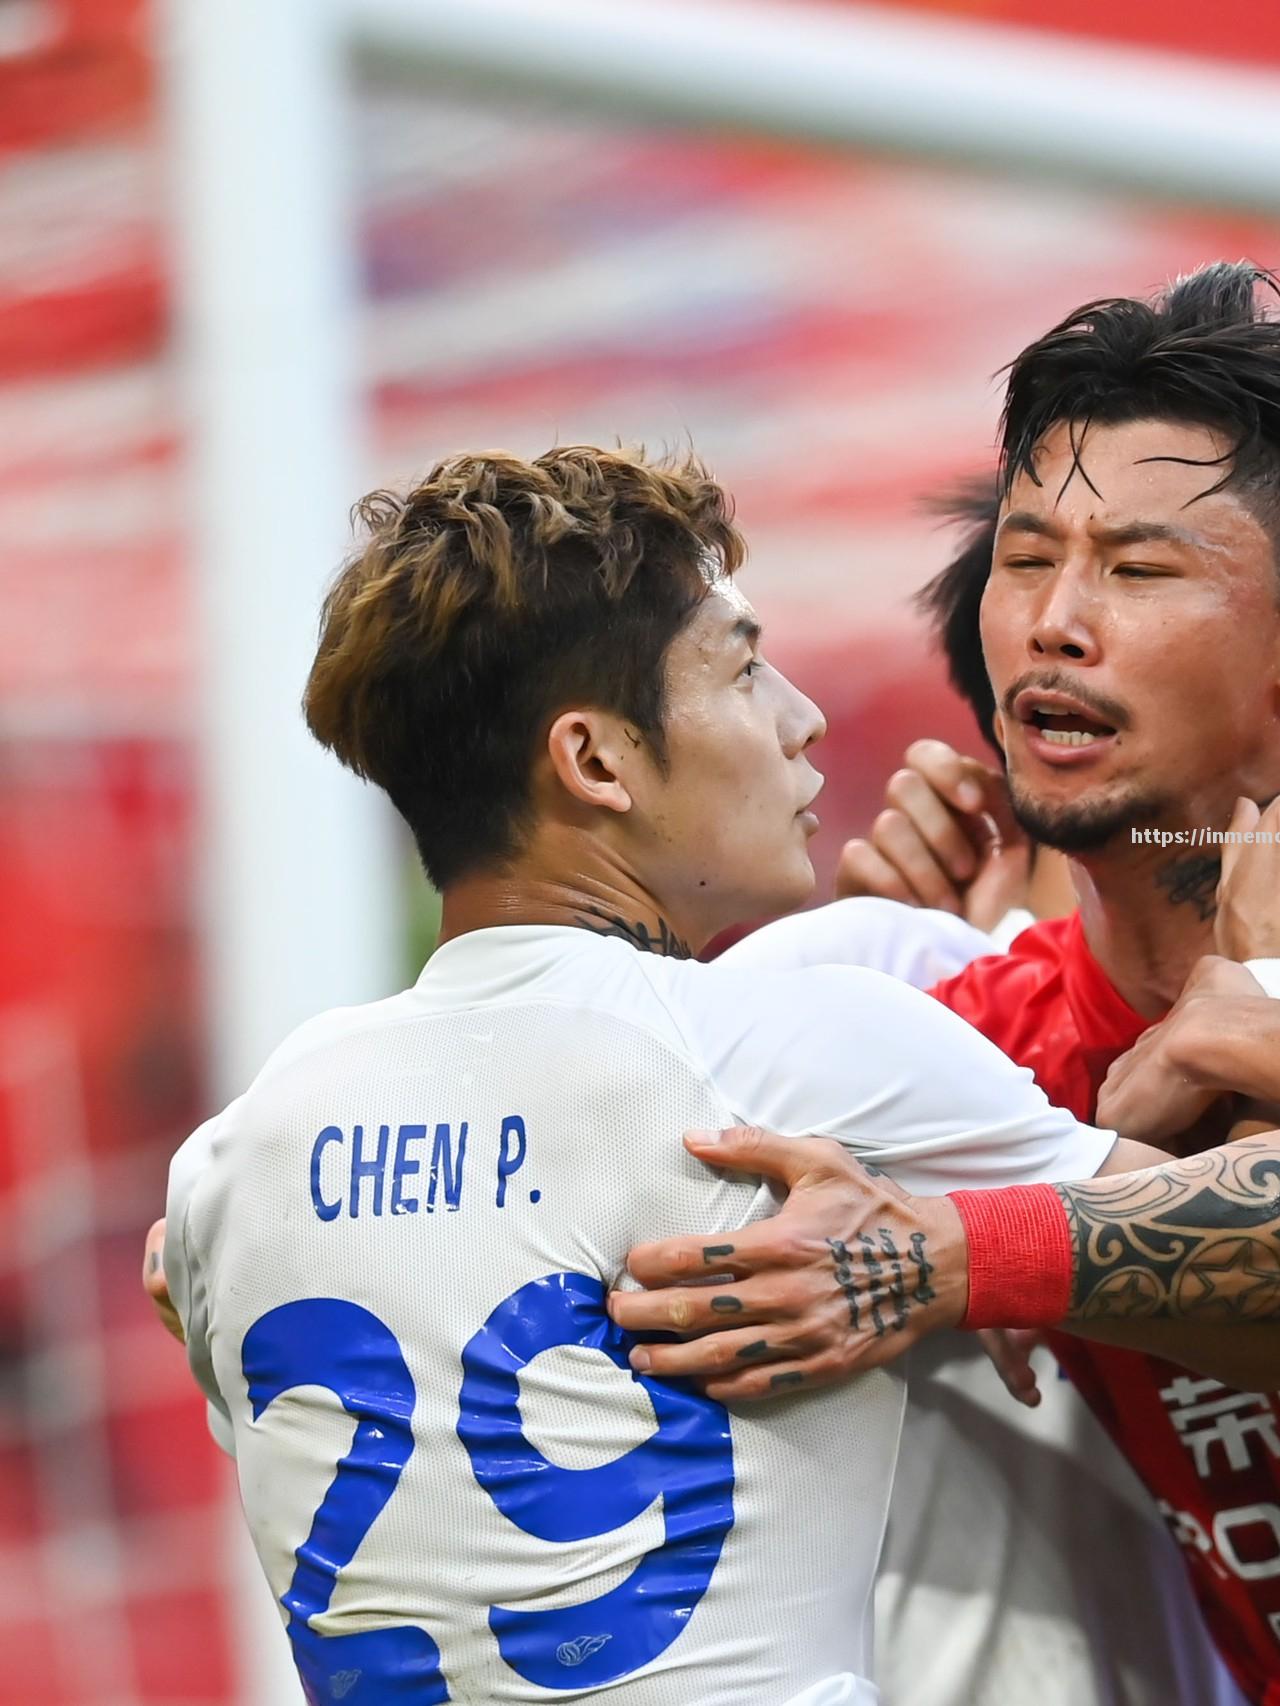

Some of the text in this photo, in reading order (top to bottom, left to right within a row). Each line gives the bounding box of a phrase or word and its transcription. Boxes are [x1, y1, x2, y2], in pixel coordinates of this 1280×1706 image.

[310, 1114, 542, 1223] CHEN P.
[241, 1271, 736, 1706] 29
